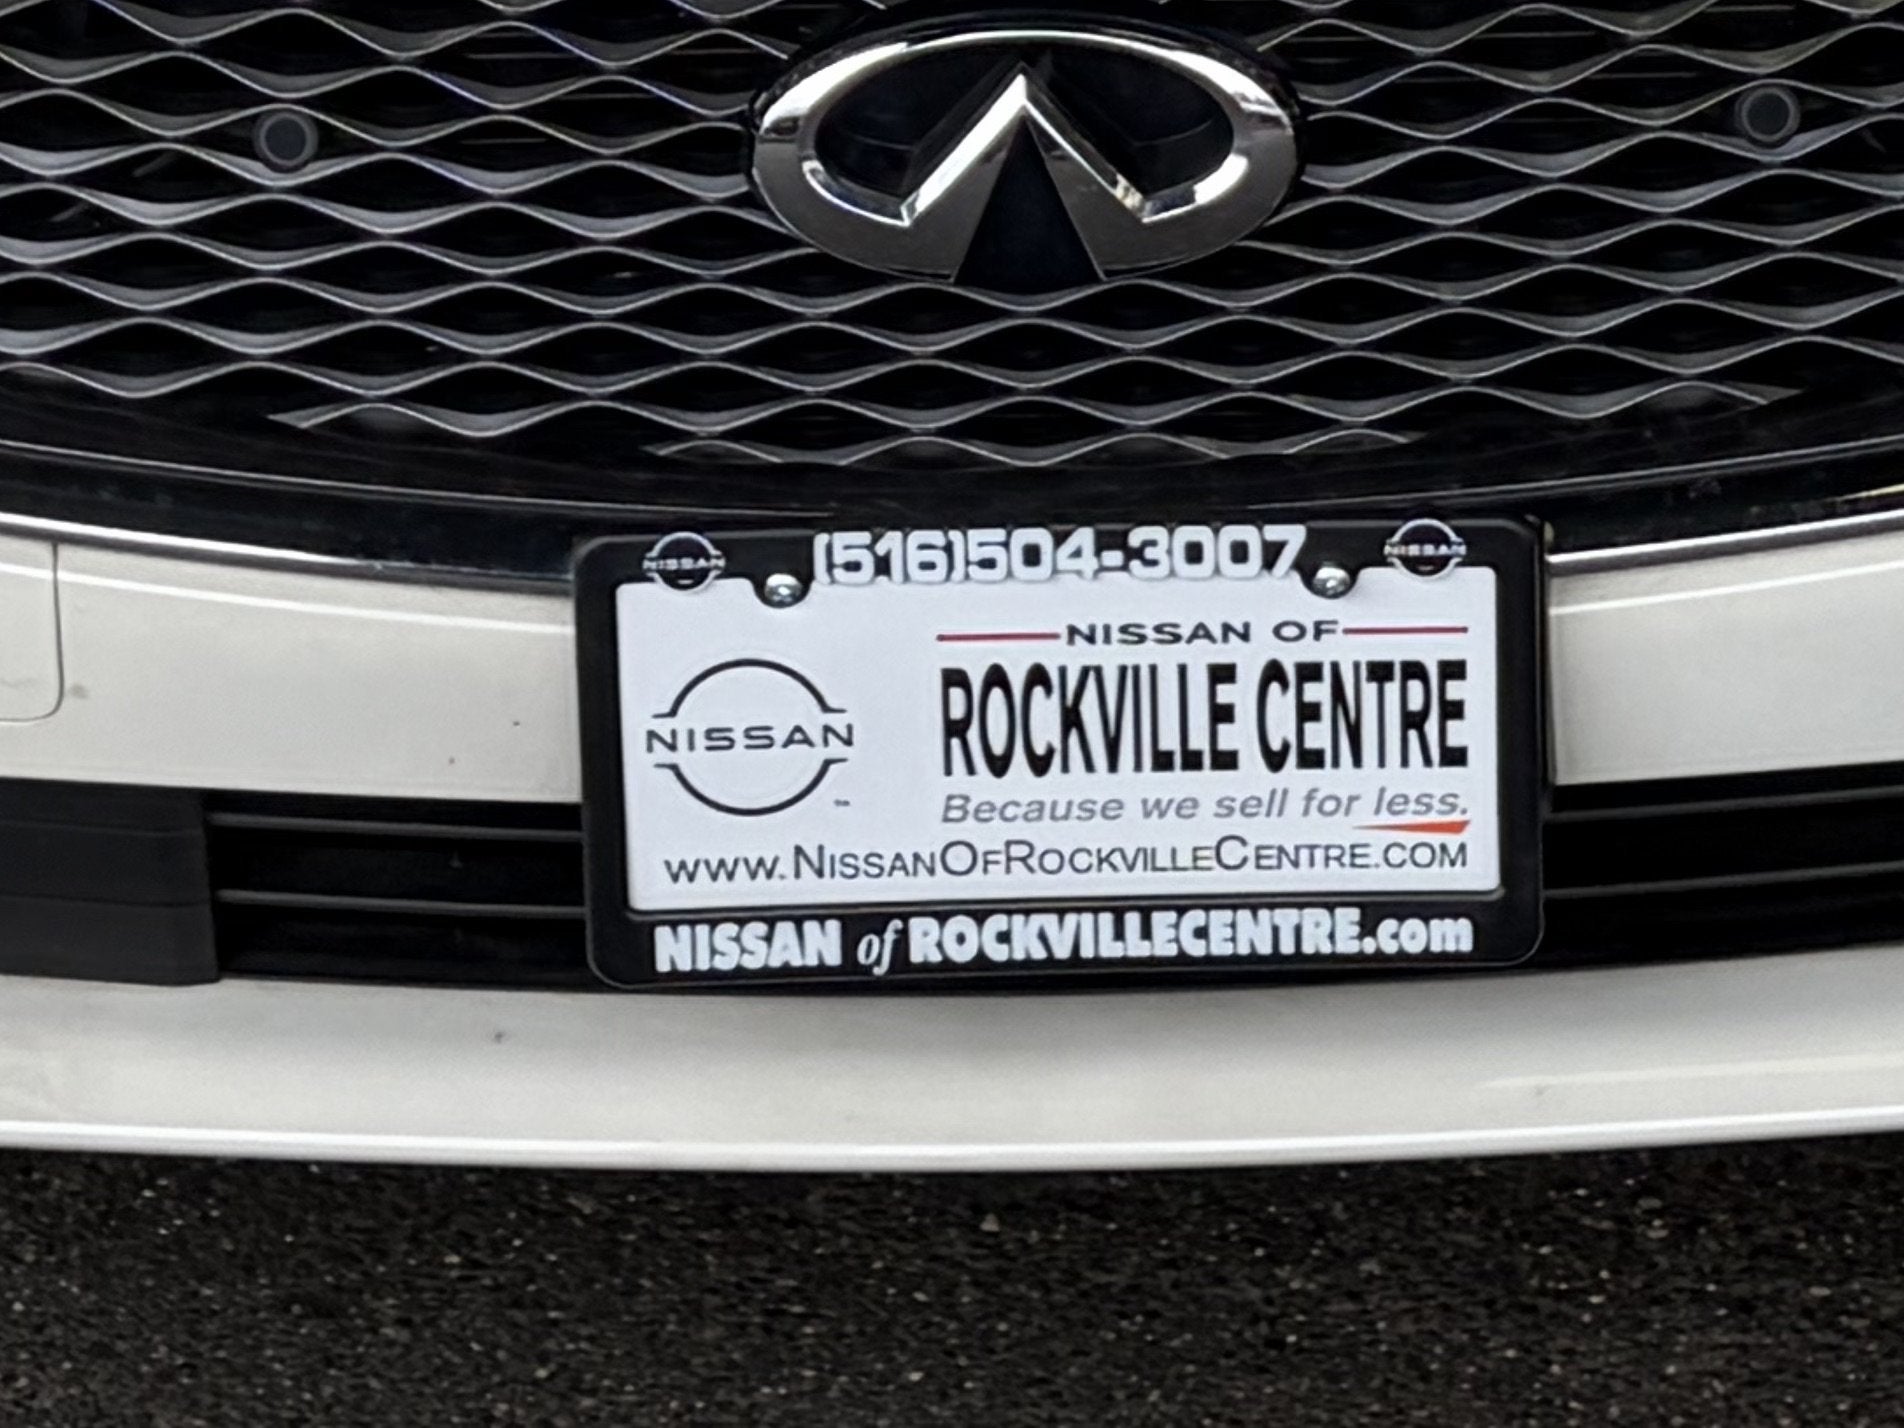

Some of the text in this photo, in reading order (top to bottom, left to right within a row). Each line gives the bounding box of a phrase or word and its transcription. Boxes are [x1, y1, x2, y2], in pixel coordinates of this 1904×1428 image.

[1065, 620, 1338, 645] NISSAN OF
[940, 658, 1468, 779] ROCKVILLE CENTRE
[646, 723, 854, 753] NISSAN
[941, 787, 1468, 823] Because we sell for less.
[653, 907, 1474, 976] NISSAN of ROCKVILLECENTRE.com
